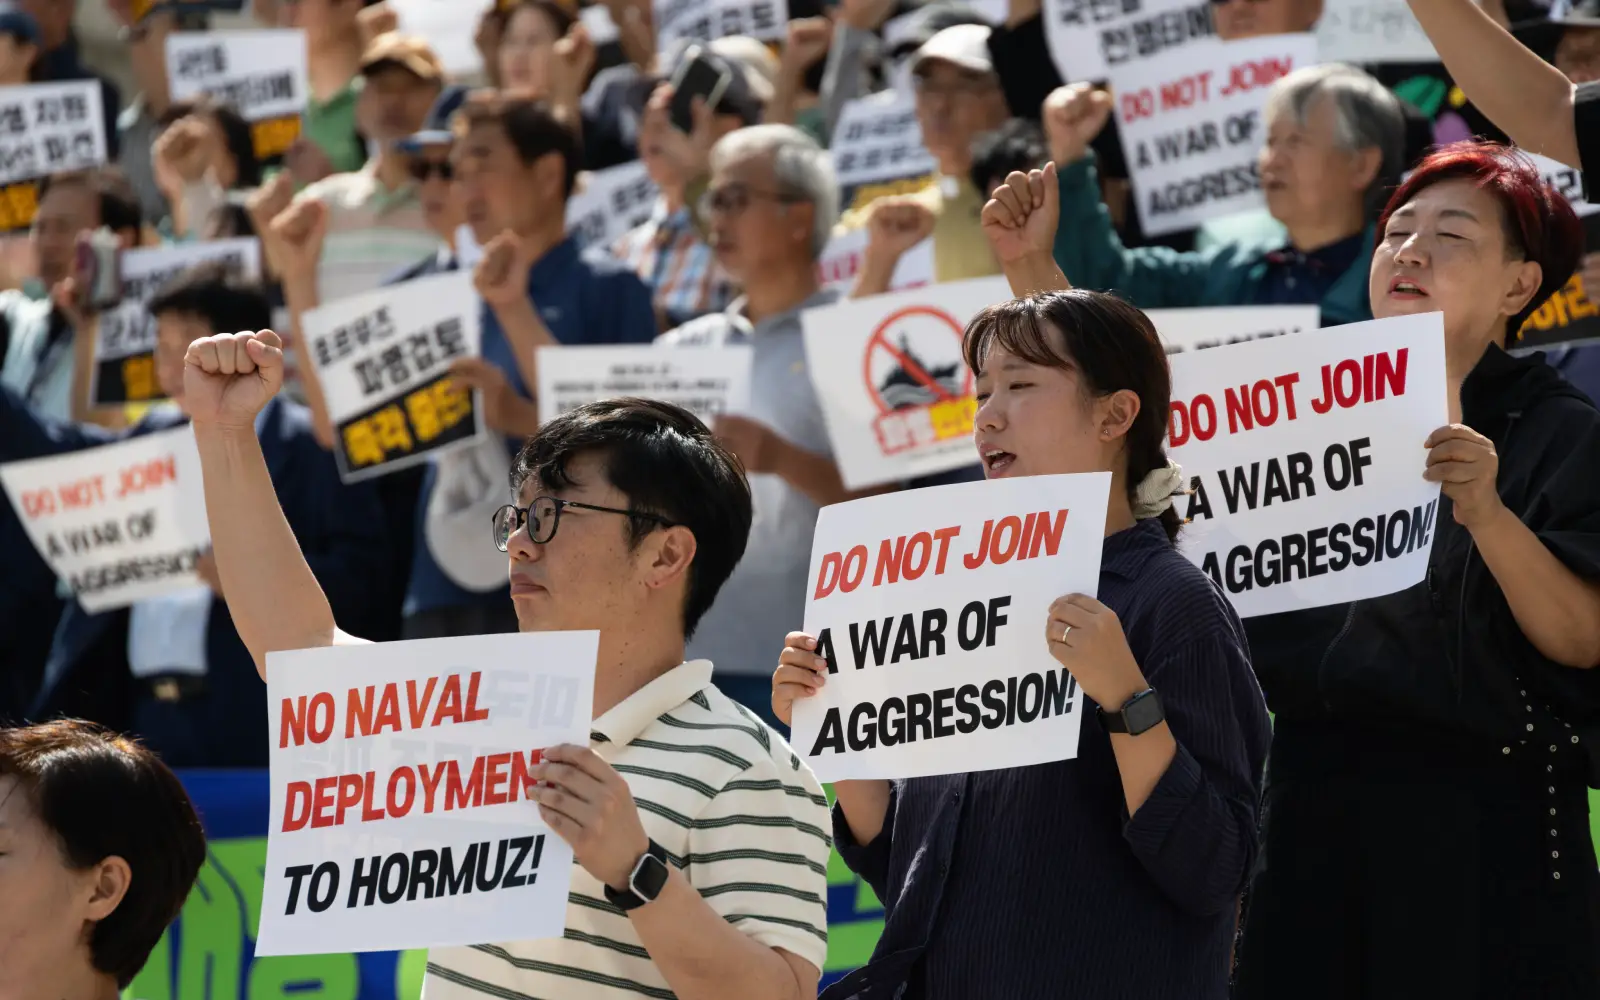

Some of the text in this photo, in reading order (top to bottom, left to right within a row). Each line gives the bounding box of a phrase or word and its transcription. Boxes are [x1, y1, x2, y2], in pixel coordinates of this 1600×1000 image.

[1121, 56, 1293, 124] DO NOT JOIN
[1136, 109, 1259, 169] A WAR OF
[1149, 159, 1263, 216] AGGRESS
[1168, 347, 1408, 448] DO NOT JOIN
[21, 453, 177, 520] DO NOT JOIN
[1186, 437, 1371, 521] A WAR OF
[46, 508, 156, 559] A WAR OF
[814, 509, 1069, 600] DO NOT JOIN
[1200, 498, 1438, 594] AGGRESSION!
[814, 595, 1011, 675] A WAR OF
[279, 671, 489, 748] NO NAVAL
[809, 667, 1077, 757] AGGRESSION!
[281, 747, 555, 832] DEPLOYMEN
[284, 834, 546, 915] TO HORMUZ!
